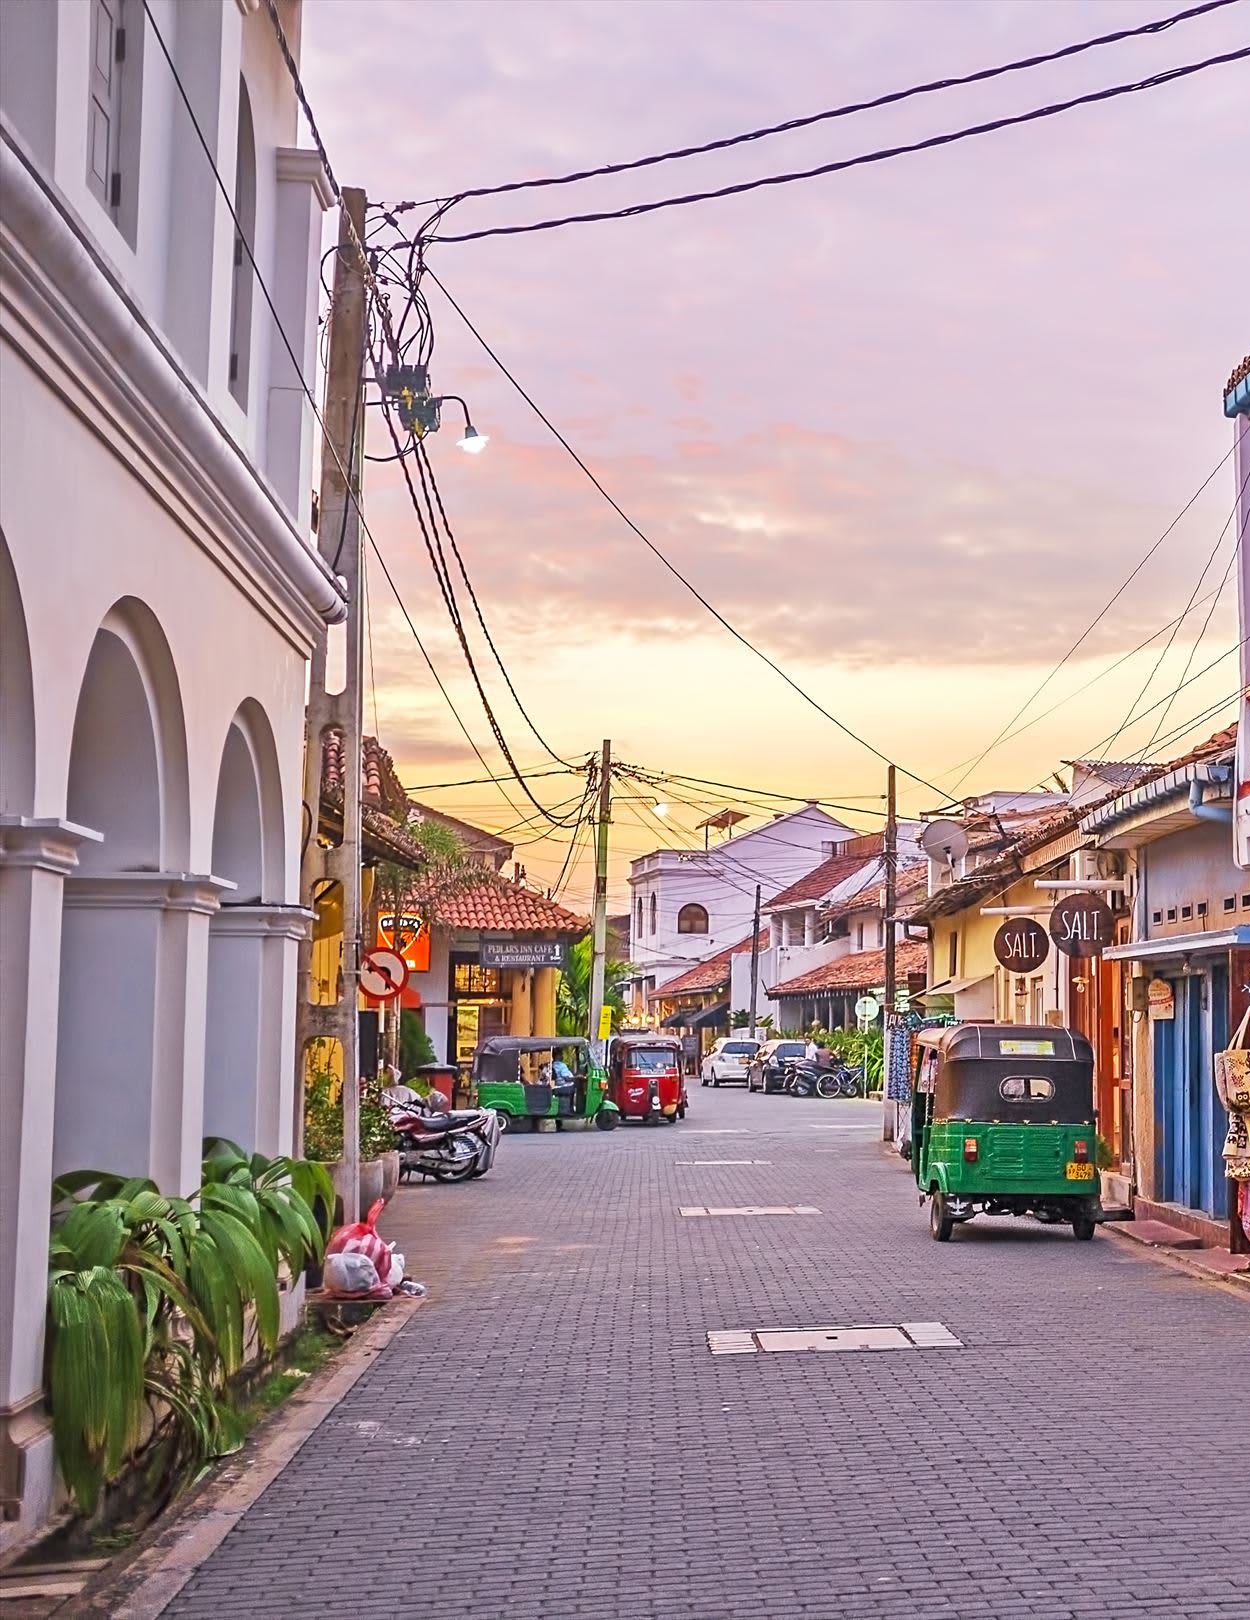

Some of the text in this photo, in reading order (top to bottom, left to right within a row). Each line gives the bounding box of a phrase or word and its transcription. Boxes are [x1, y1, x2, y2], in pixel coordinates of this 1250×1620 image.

[1060, 910, 1103, 940] SALT.
[501, 954, 546, 962] RESTAURANT
[1004, 932, 1040, 959] SALT.
